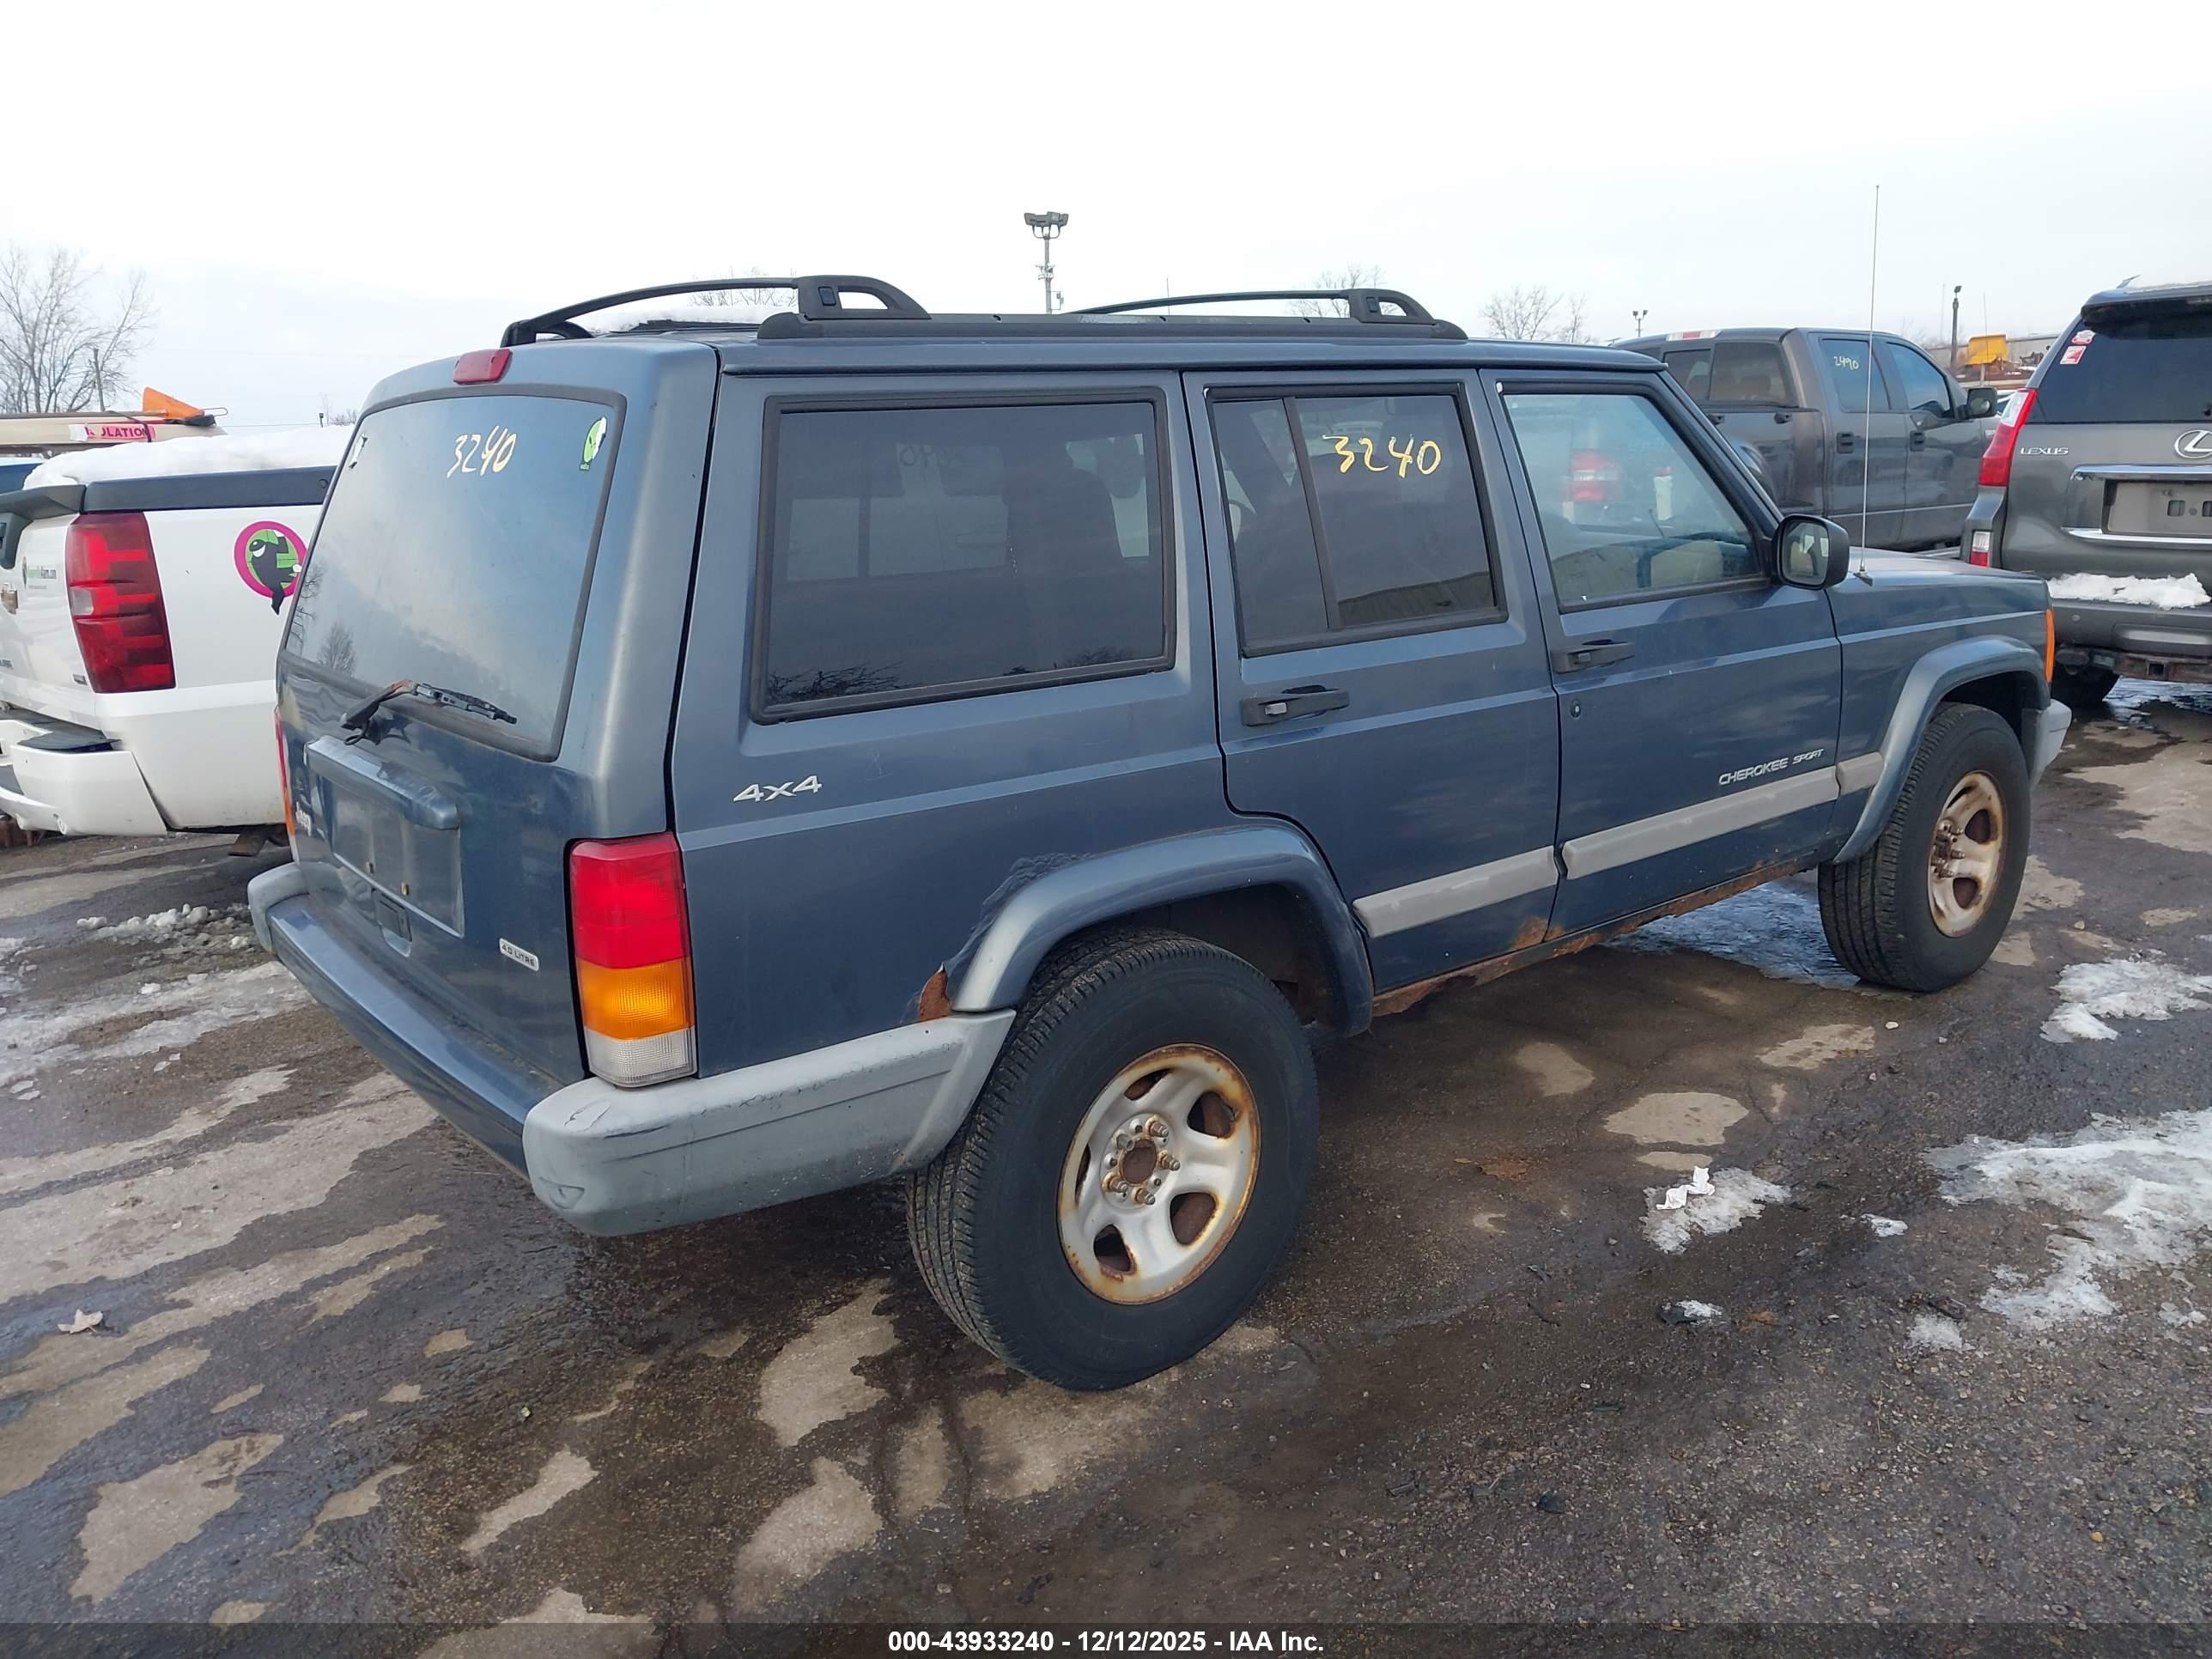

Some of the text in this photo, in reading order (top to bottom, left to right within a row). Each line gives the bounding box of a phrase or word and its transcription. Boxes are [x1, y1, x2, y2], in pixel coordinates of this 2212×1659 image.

[1833, 356, 1860, 371] 2490
[447, 425, 517, 479] 3240
[1322, 433, 1442, 478] 3240
[2020, 447, 2069, 456] LEXUS
[1718, 748, 1825, 786] CHEROKEE SPORT
